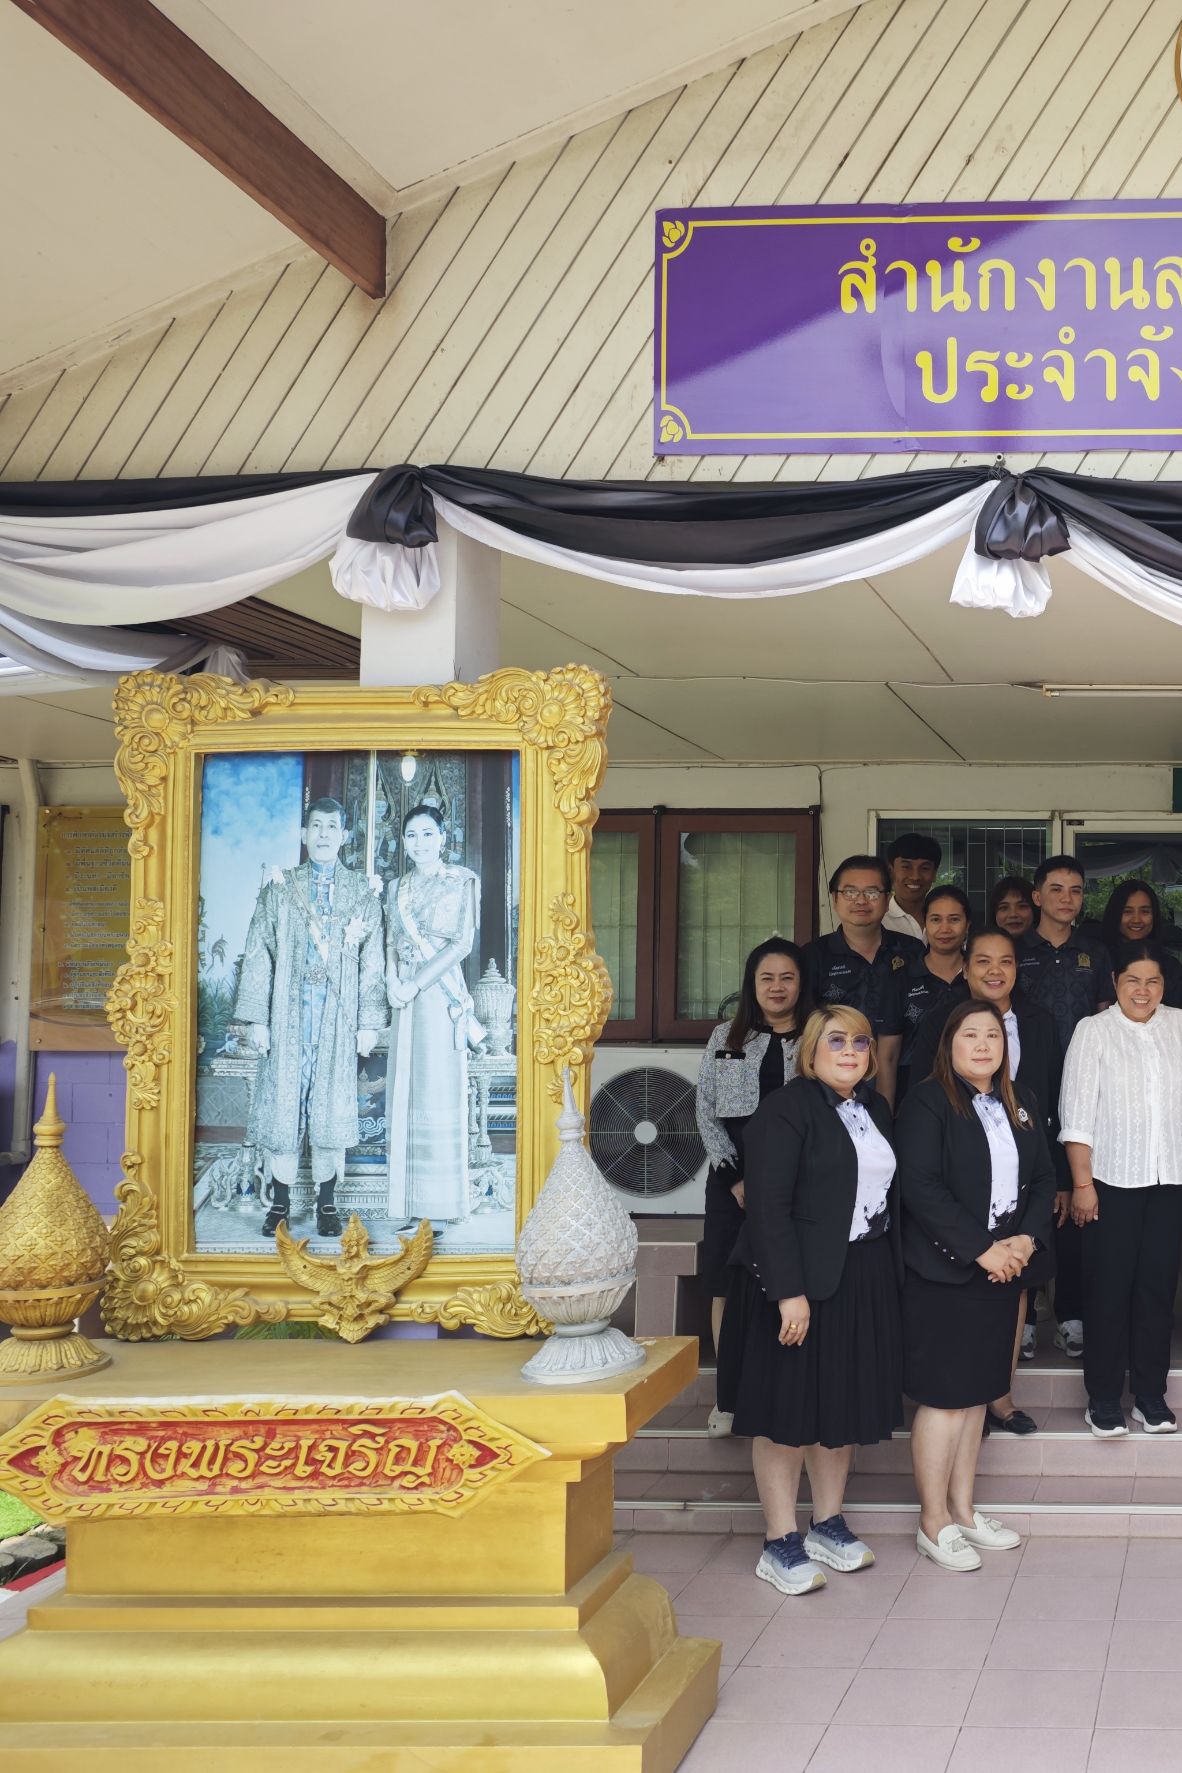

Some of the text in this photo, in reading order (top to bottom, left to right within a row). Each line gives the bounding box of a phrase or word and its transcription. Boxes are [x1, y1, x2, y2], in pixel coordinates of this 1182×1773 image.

[68, 1422, 439, 1490] ทรงพระเจริญ
